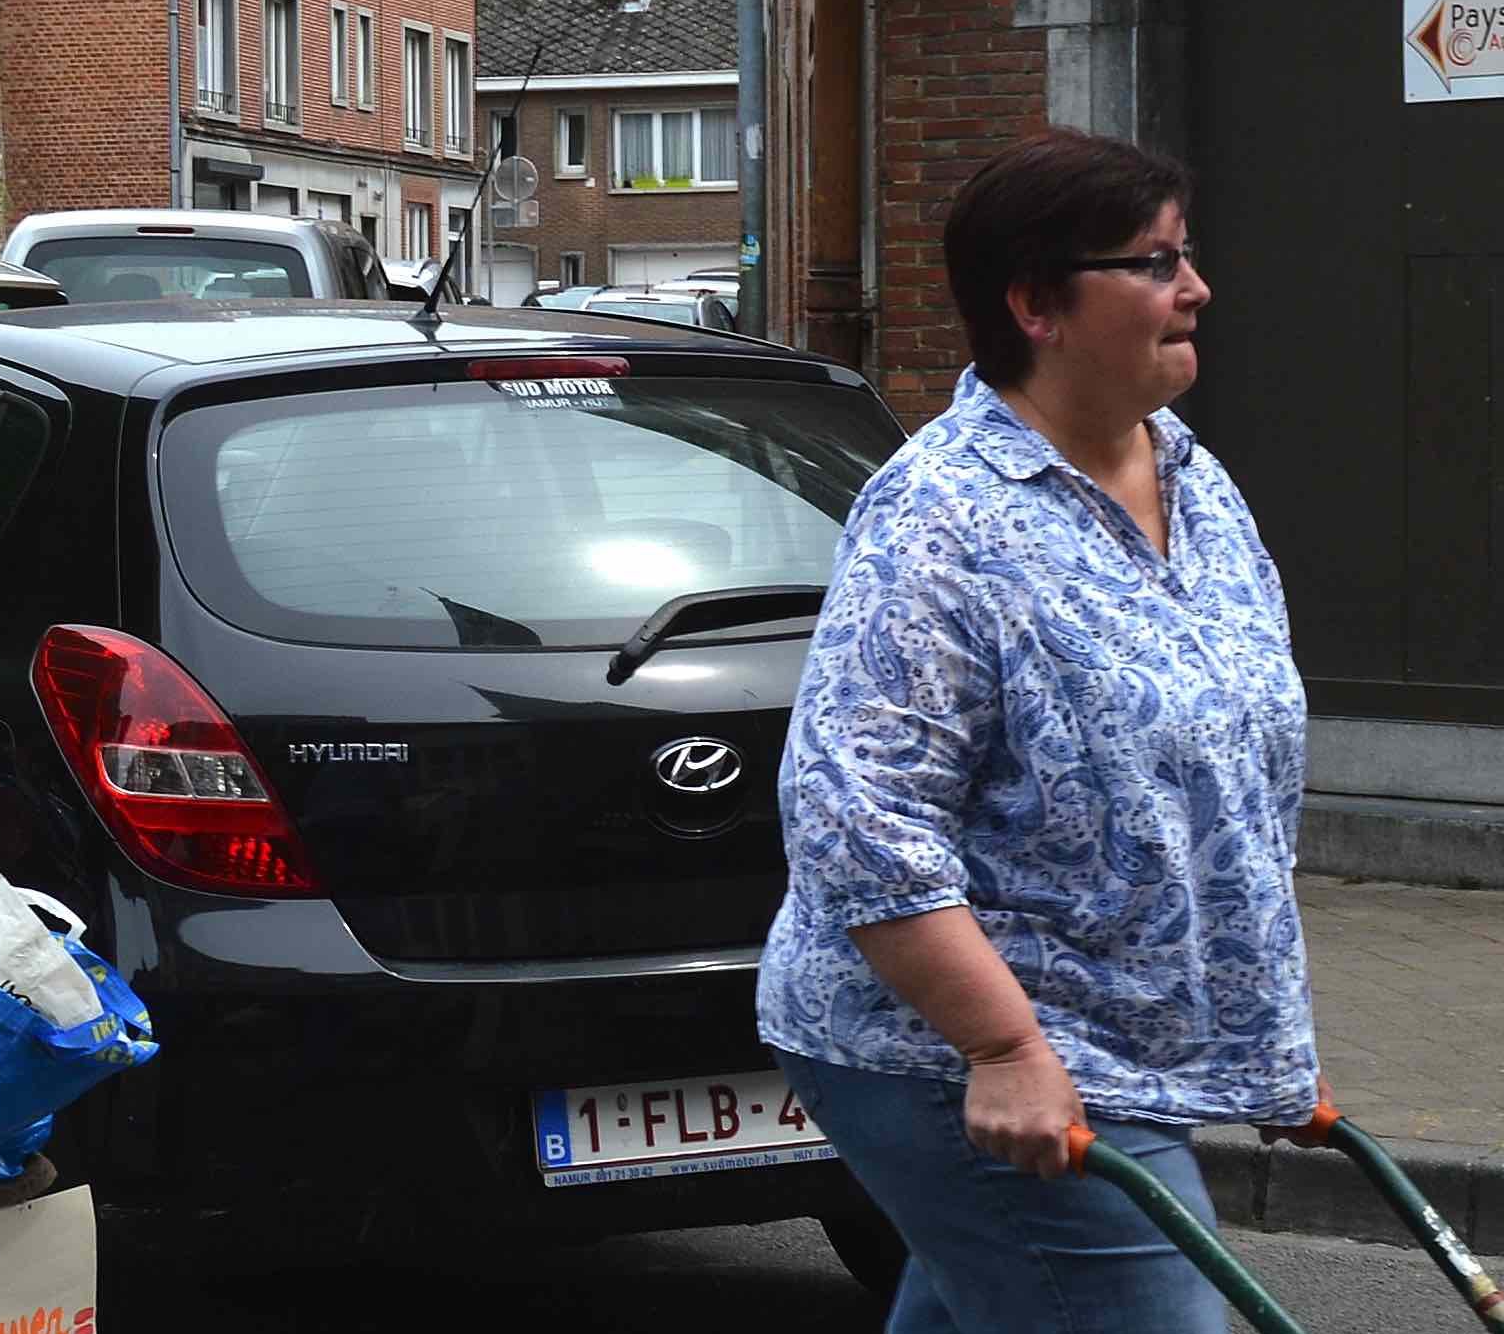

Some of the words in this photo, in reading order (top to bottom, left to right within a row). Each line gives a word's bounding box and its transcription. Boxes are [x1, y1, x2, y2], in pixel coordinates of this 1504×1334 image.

[500, 379, 542, 397] SUD
[544, 379, 615, 396] MOTOR
[287, 742, 409, 765] HYUNDAI
[545, 1134, 566, 1161] B
